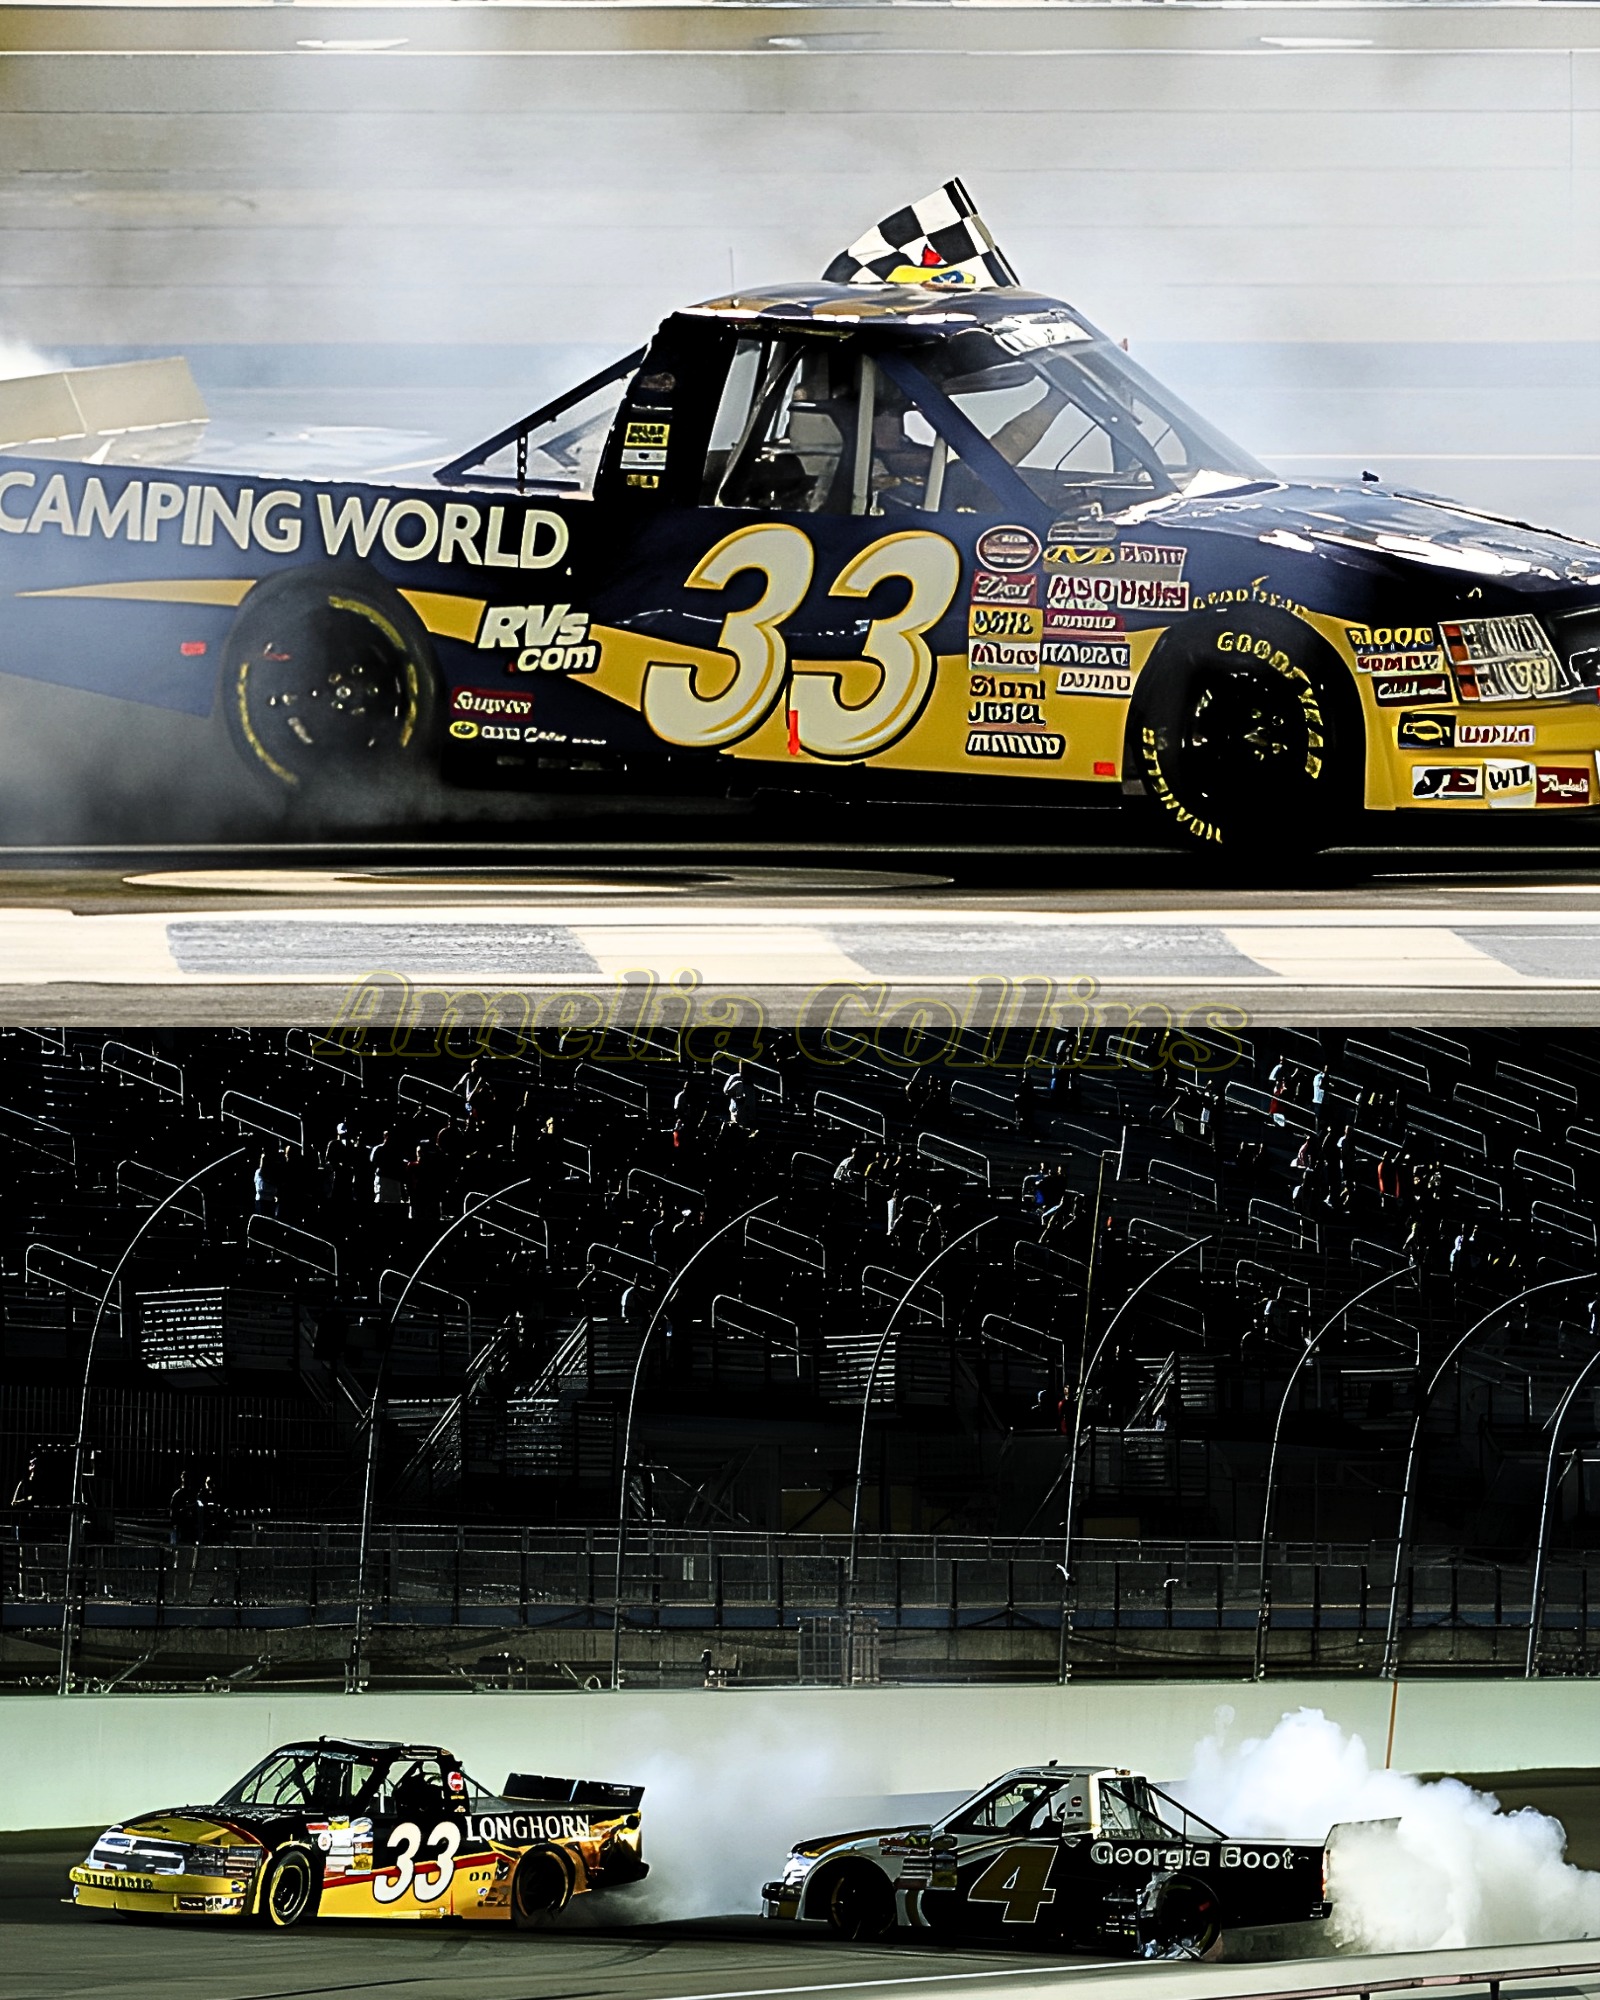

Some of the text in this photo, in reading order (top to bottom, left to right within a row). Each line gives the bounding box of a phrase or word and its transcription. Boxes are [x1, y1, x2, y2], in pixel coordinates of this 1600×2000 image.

[0, 471, 569, 569] CAMPING WORLD
[477, 603, 590, 649] RVs
[644, 522, 961, 756] 33
[372, 1820, 462, 1903] 33
[464, 1813, 590, 1843] LONGHORN
[1090, 1841, 1295, 1870] Georgia Boot
[967, 1845, 1059, 1924] 4
